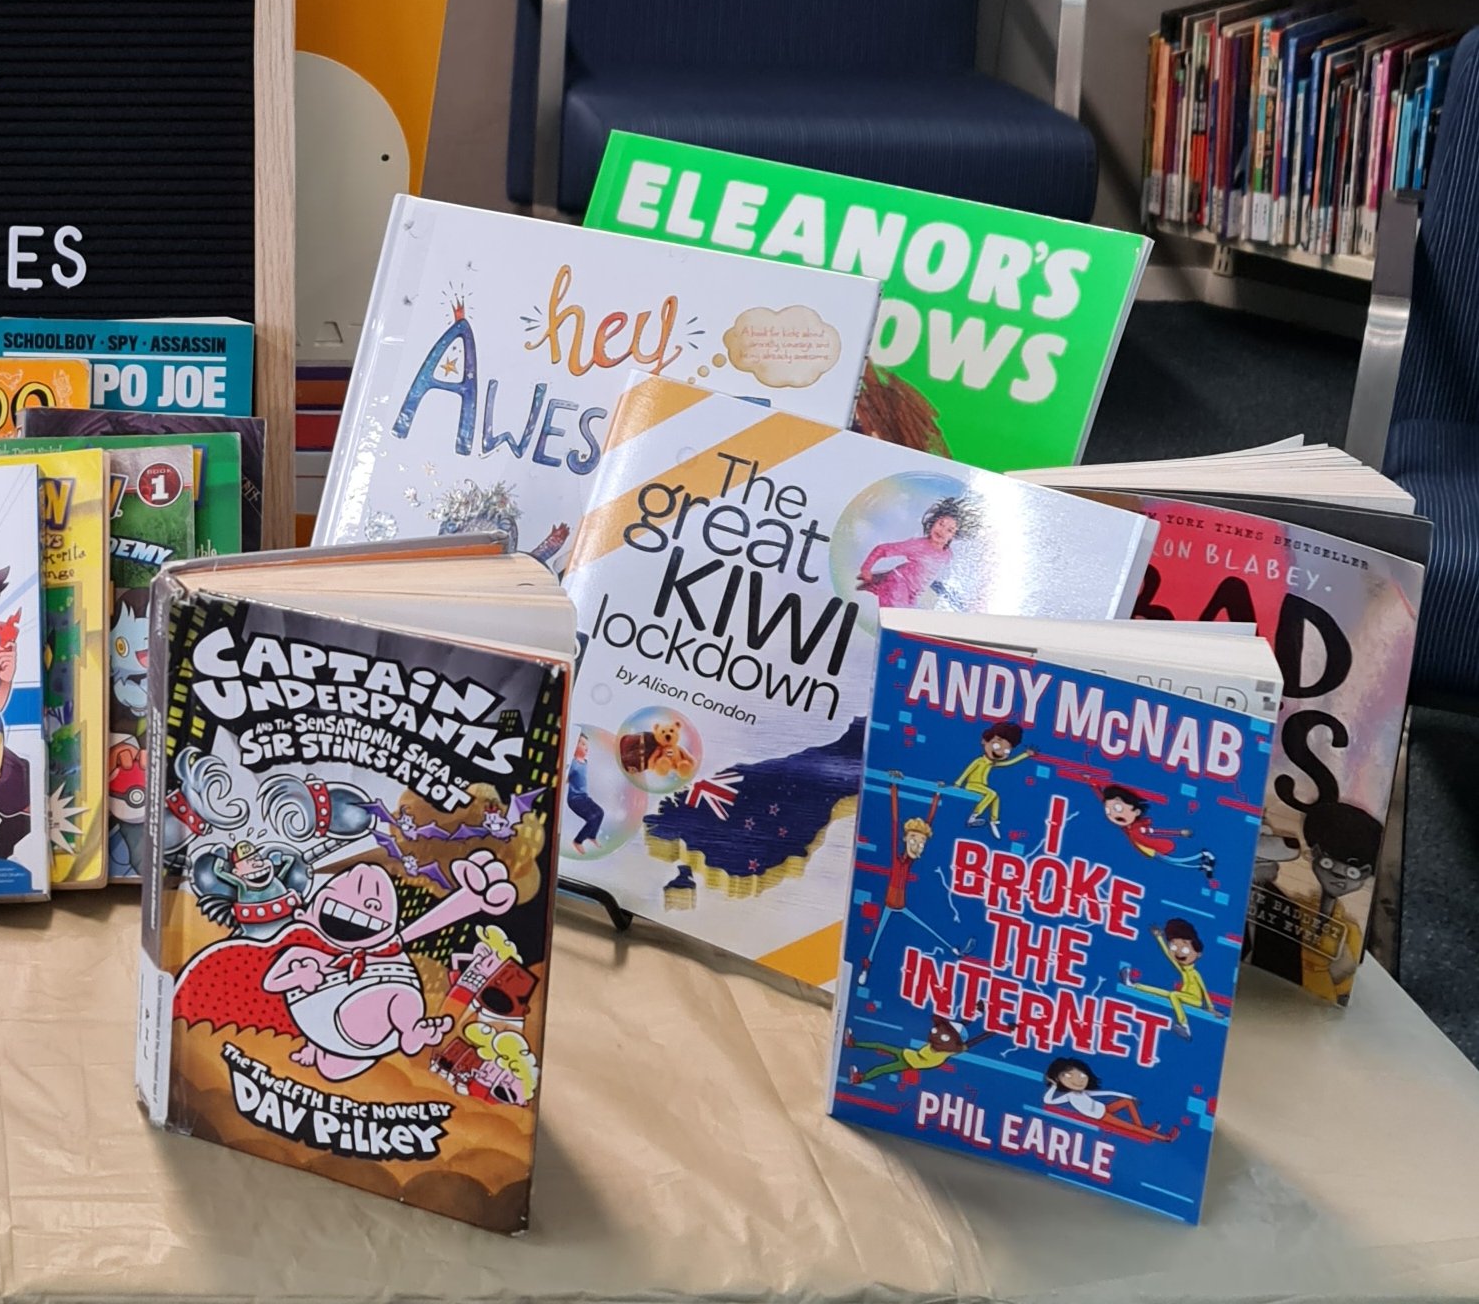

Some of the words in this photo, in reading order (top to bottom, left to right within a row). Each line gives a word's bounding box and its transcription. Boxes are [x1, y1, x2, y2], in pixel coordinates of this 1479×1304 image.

[615, 159, 1093, 322] ELEANOR'S
[3, 332, 96, 351] SCHOOLBOY
[108, 334, 139, 353] SPY
[150, 335, 226, 354] ASSASSIN
[524, 263, 684, 377] hey
[869, 296, 1070, 405] OWS
[93, 363, 147, 407] PO
[157, 365, 227, 409] JOE
[391, 318, 608, 476] AWES
[150, 474, 170, 501] 1
[717, 451, 808, 520] The
[109, 538, 174, 564] DEMY
[623, 482, 831, 584] great
[1166, 513, 1205, 530] YORK
[1215, 522, 1265, 542] TIMES
[1273, 534, 1371, 571] BESTSELLER
[1206, 542, 1334, 594] BLABEY.
[653, 545, 860, 677] KIWI
[192, 626, 497, 723] CAPTAIN
[591, 593, 841, 722] lockdown
[908, 650, 1053, 728] ANDY
[192, 678, 524, 776] UNDERPANTS
[615, 665, 638, 686] by
[638, 673, 689, 702] Alison
[691, 691, 758, 727] Condon
[239, 729, 295, 766] SIR
[255, 719, 274, 736] AND
[403, 742, 452, 781] SAGA
[454, 775, 470, 790] OF
[1043, 794, 1069, 856] I
[950, 837, 1145, 941] BROKE
[1248, 904, 1277, 925] DAY
[1272, 899, 1341, 939] BADDEST
[985, 909, 1093, 990] THE
[898, 946, 1173, 1068] INTERNET
[231, 1070, 307, 1134] DAV
[430, 1103, 452, 1117] BY
[918, 1091, 994, 1151] PHIL
[1000, 1115, 1118, 1181] EARLE
